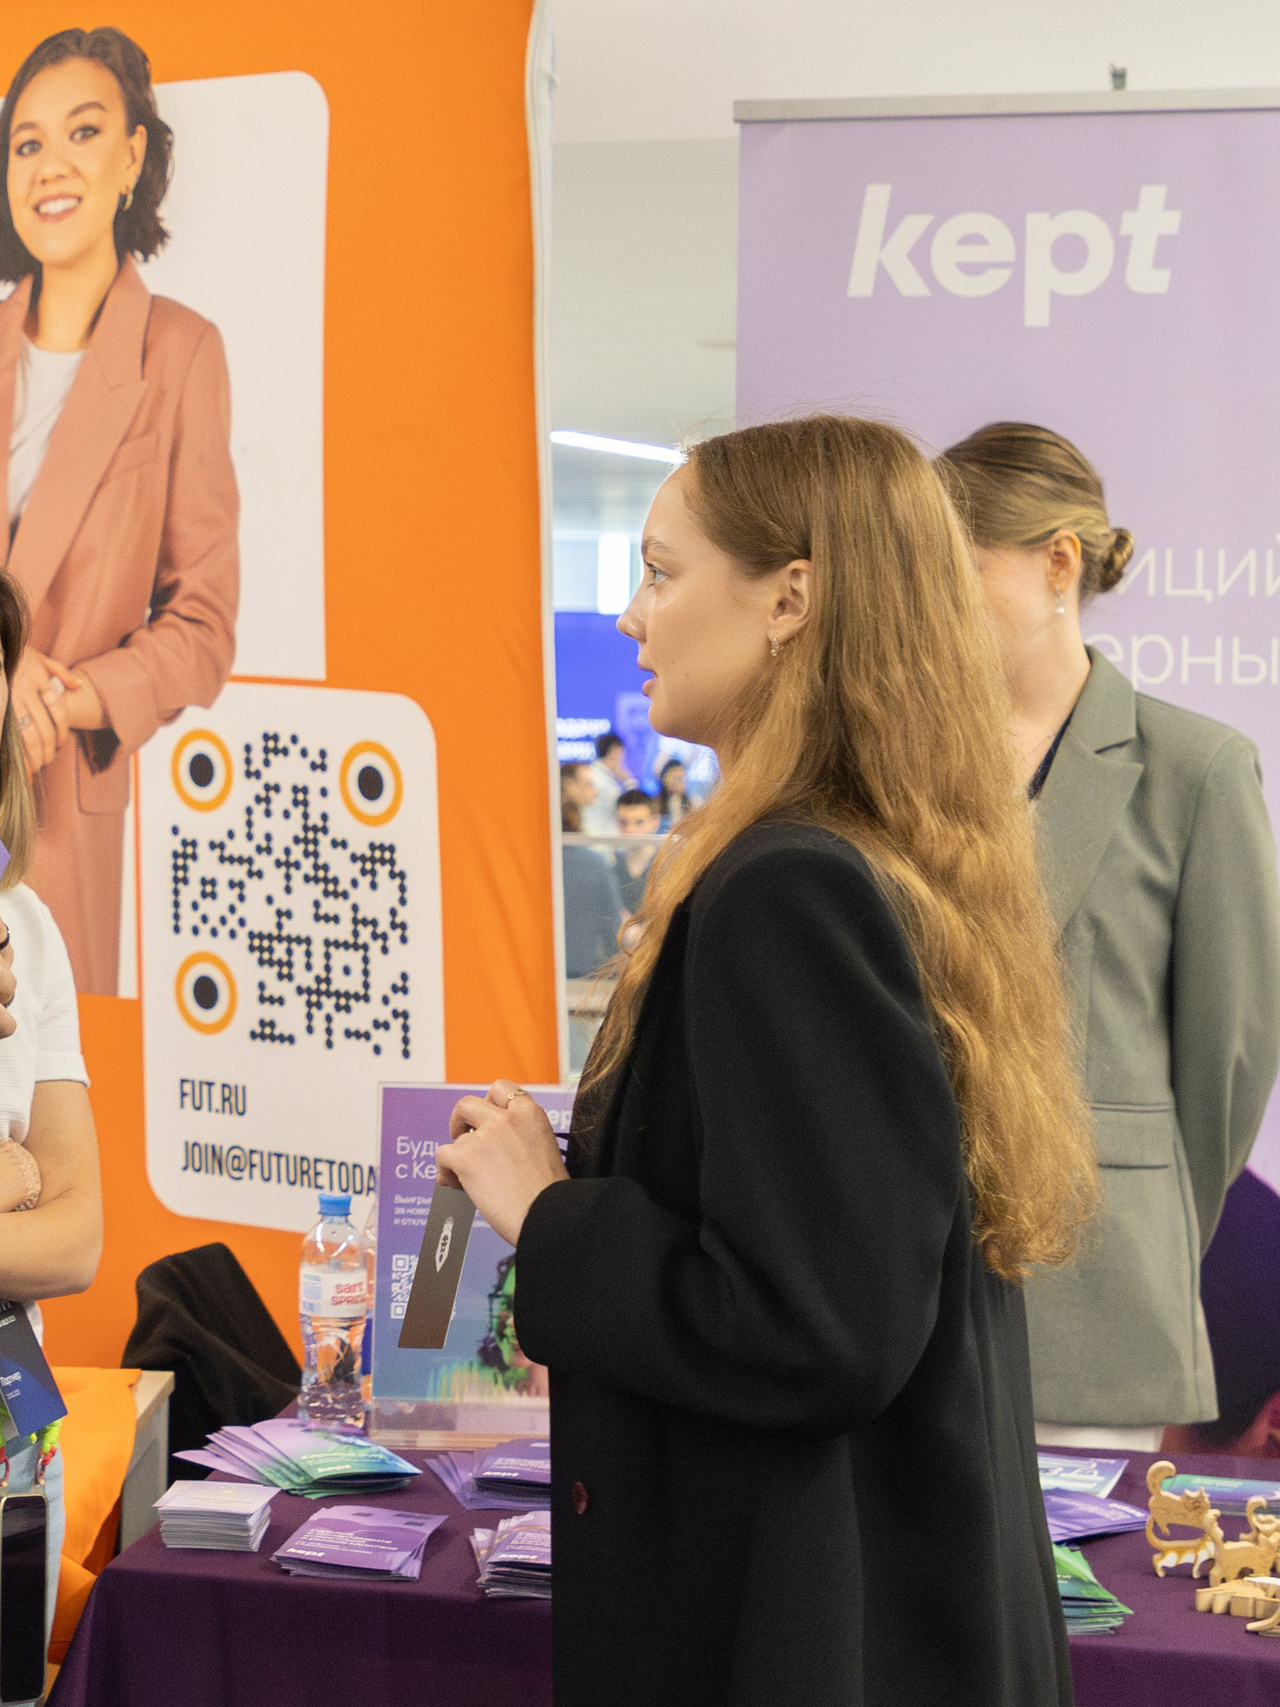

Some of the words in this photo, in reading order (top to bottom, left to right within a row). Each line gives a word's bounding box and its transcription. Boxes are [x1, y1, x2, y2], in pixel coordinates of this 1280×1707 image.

[846, 183, 1183, 328] kept
[179, 1078, 247, 1117] FUT.RU
[396, 1135, 441, 1160] Буд
